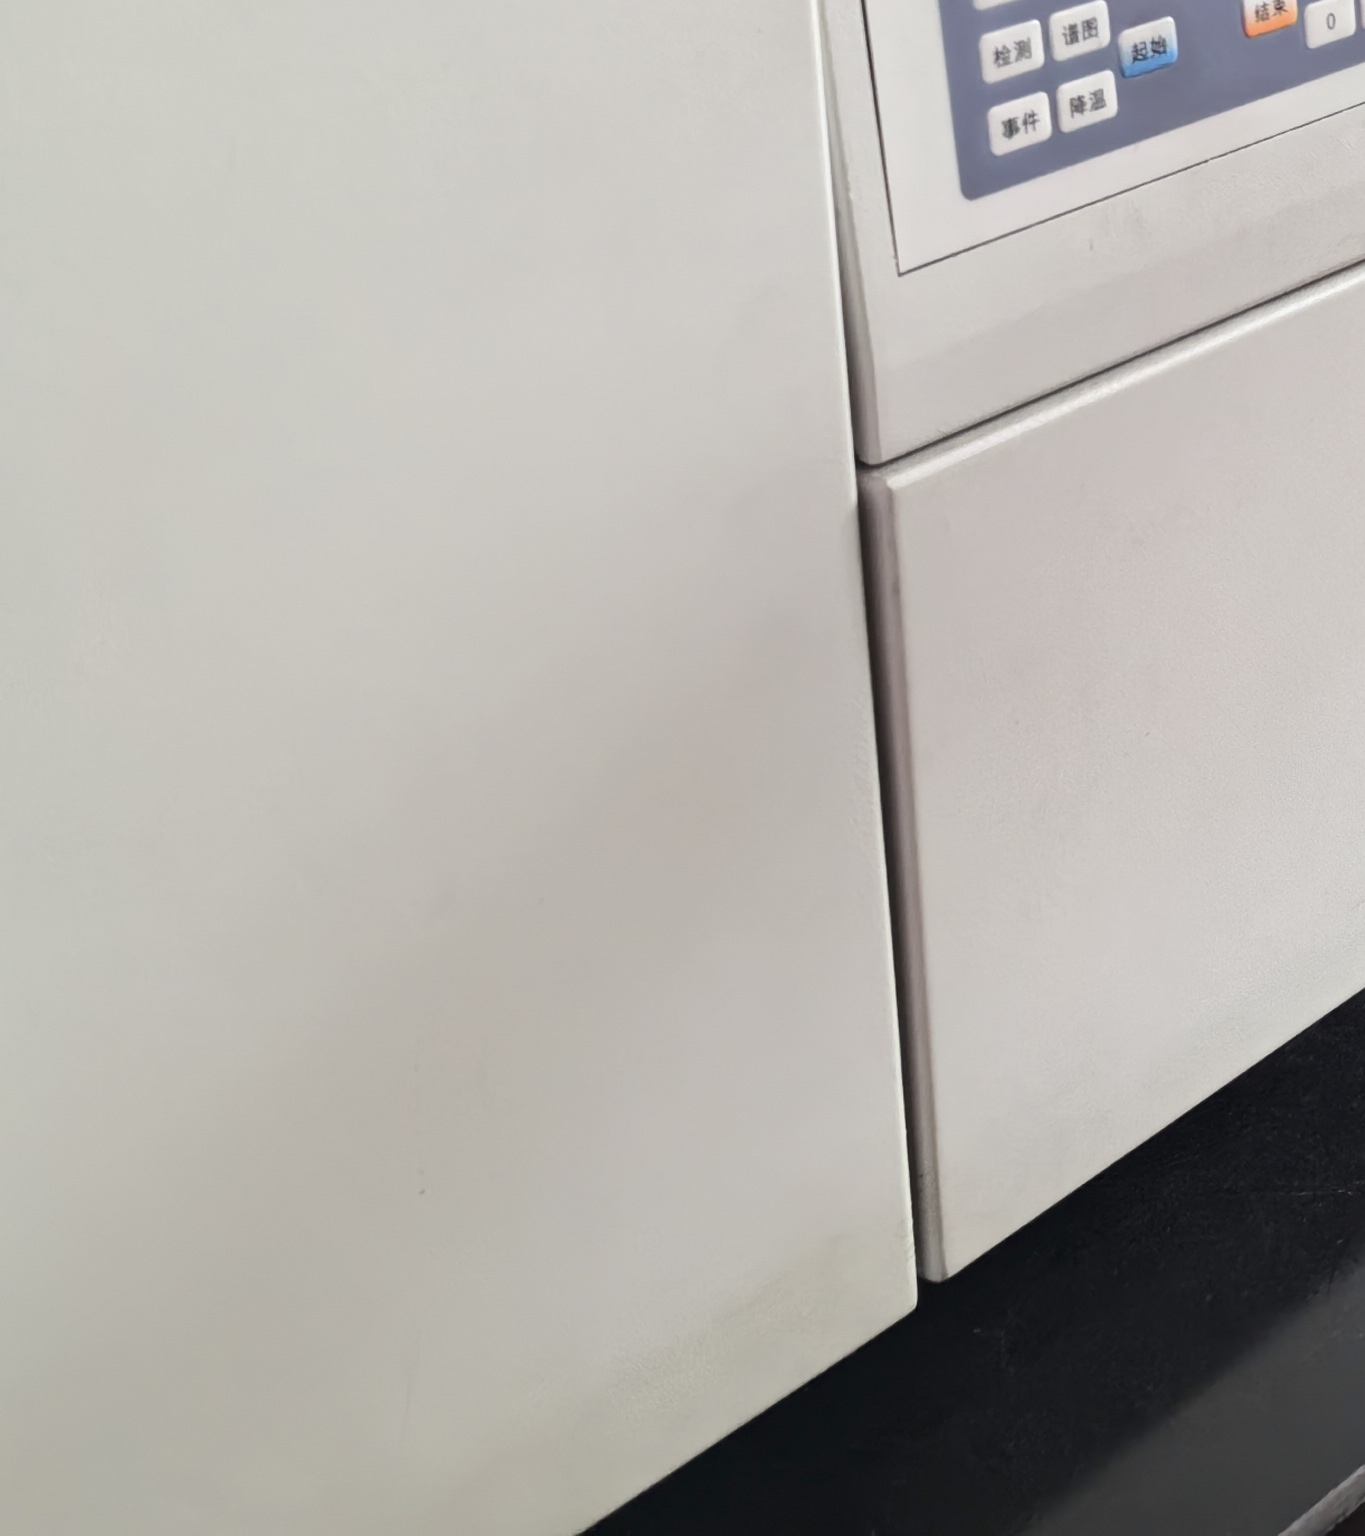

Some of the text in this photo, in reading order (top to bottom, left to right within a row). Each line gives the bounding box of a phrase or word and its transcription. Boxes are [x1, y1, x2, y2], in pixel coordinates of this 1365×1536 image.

[1061, 16, 1100, 47] 谱图
[1325, 12, 1336, 31] 0
[993, 35, 1033, 69] 检测
[1068, 87, 1108, 118] 降温
[1001, 108, 1041, 141] 事件
